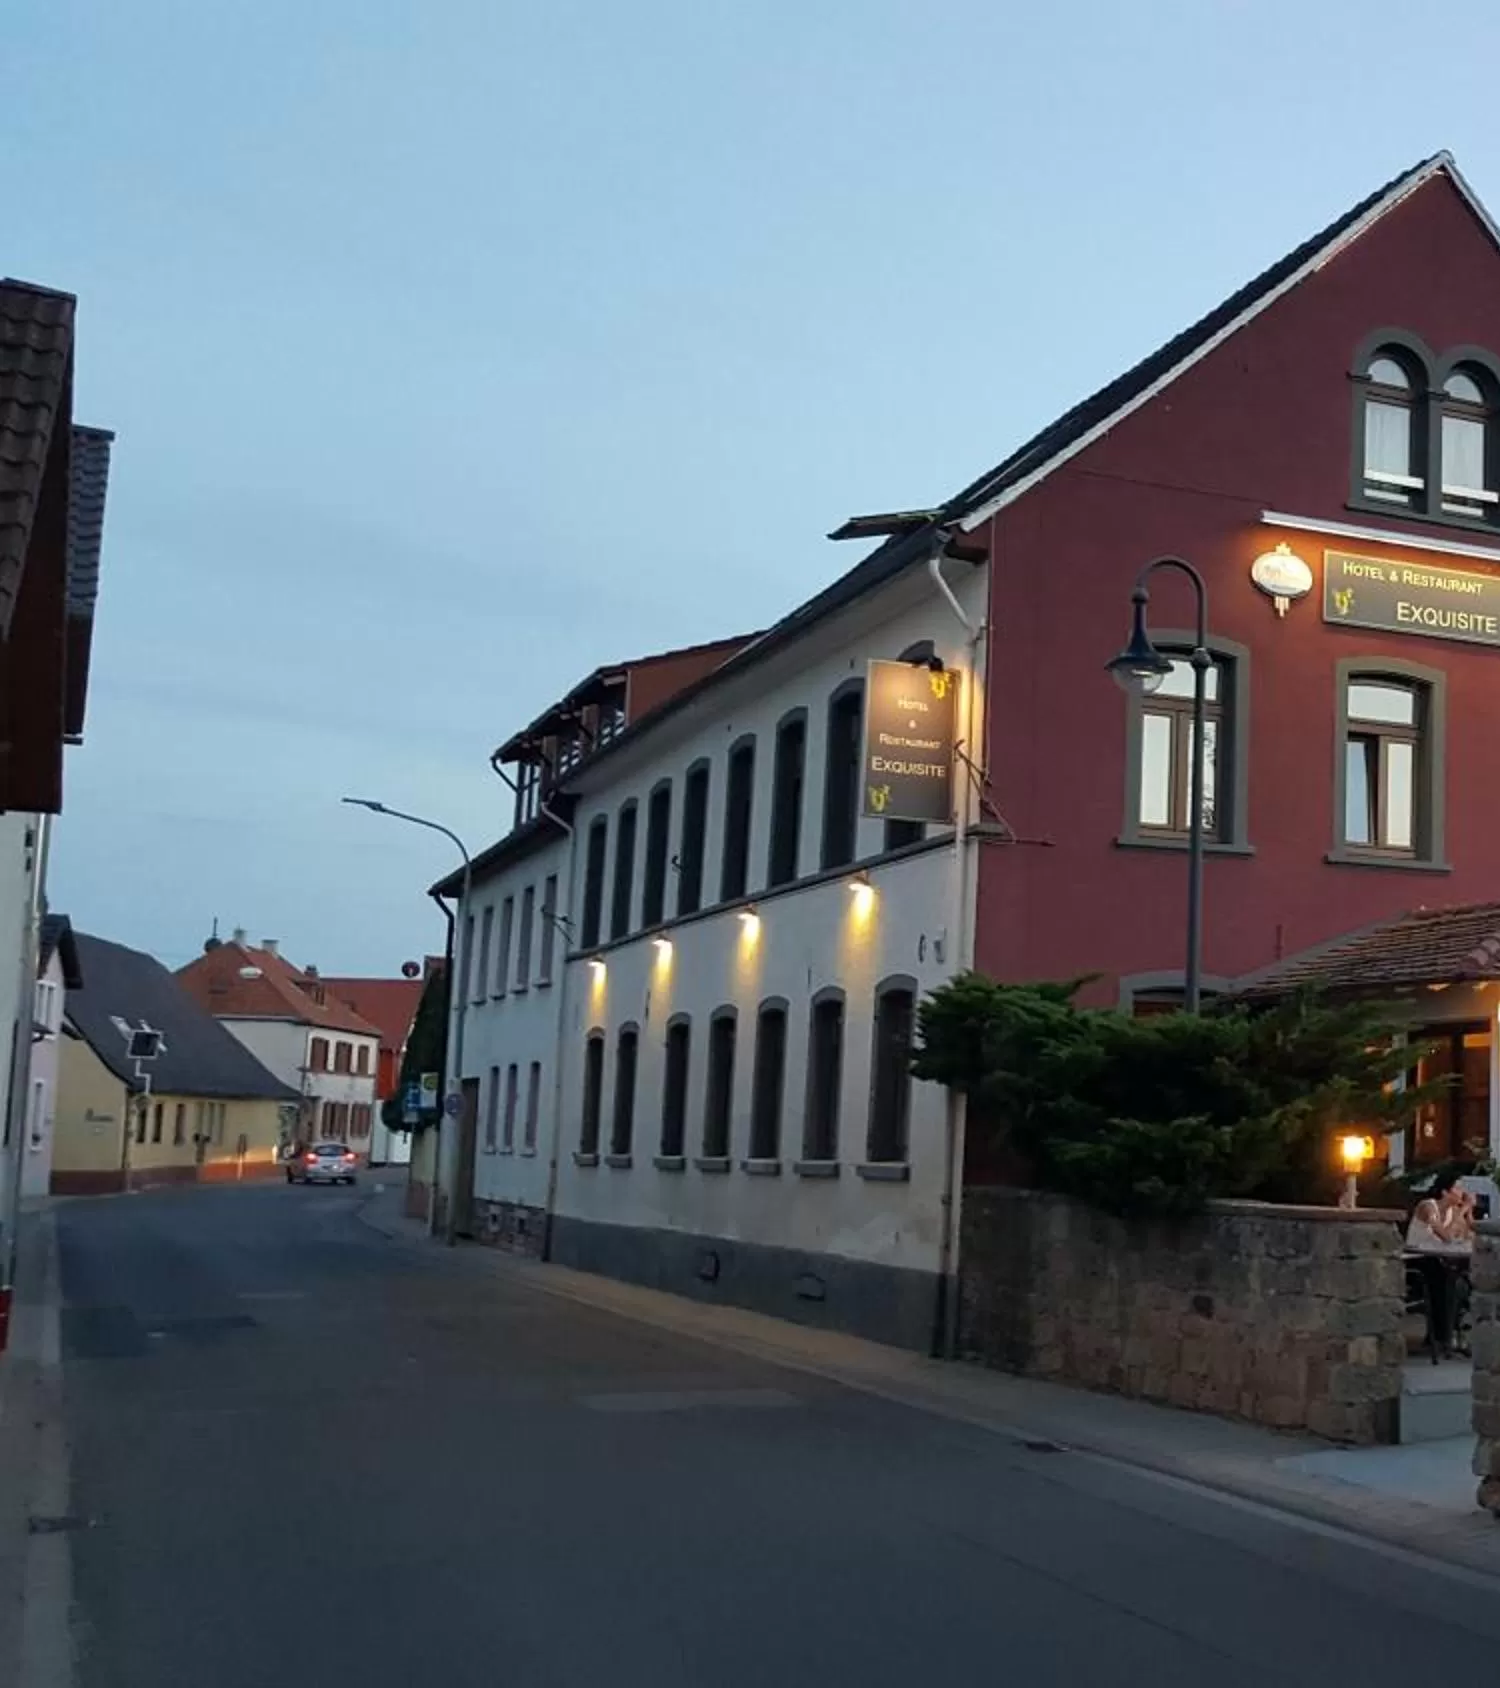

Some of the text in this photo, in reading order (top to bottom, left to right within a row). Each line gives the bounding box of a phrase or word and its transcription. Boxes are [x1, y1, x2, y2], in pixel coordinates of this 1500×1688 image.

[1343, 560, 1483, 594] HOTEL & RESTAURANT
[1397, 601, 1498, 633] EXQUISITE
[872, 755, 946, 777] EXQUISITE
